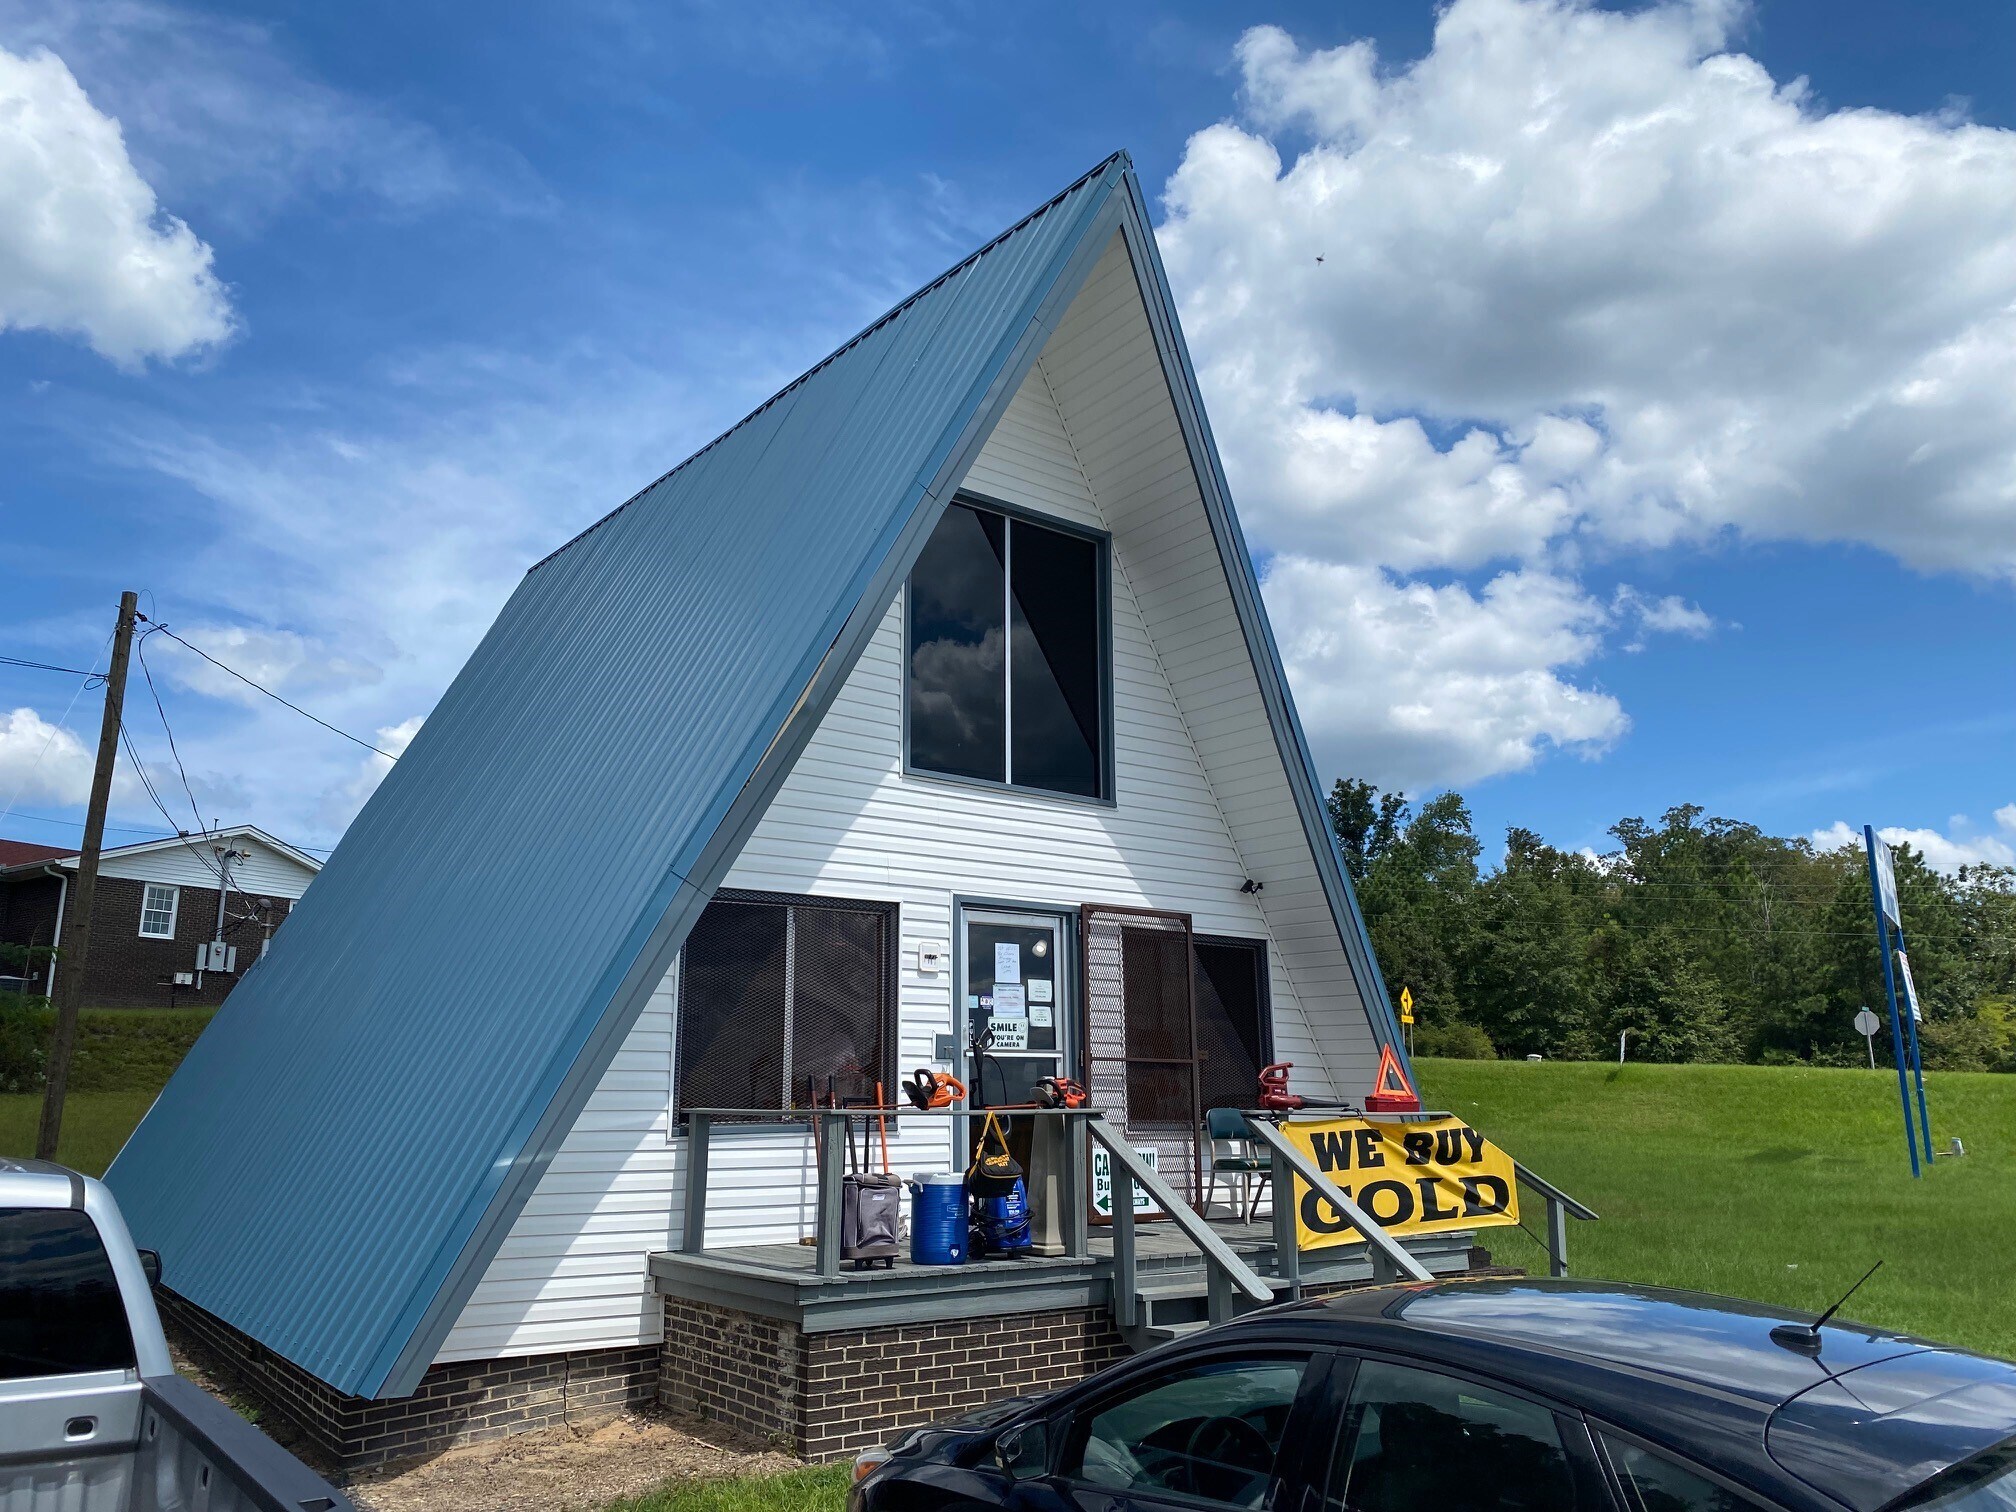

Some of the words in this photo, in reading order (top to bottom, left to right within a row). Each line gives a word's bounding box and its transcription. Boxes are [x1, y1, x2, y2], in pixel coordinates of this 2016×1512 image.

[990, 1022, 1018, 1032] SMILE
[1309, 1128, 1386, 1173] WE
[1402, 1127, 1486, 1166] BUY
[1300, 1175, 1511, 1234] GOLD
